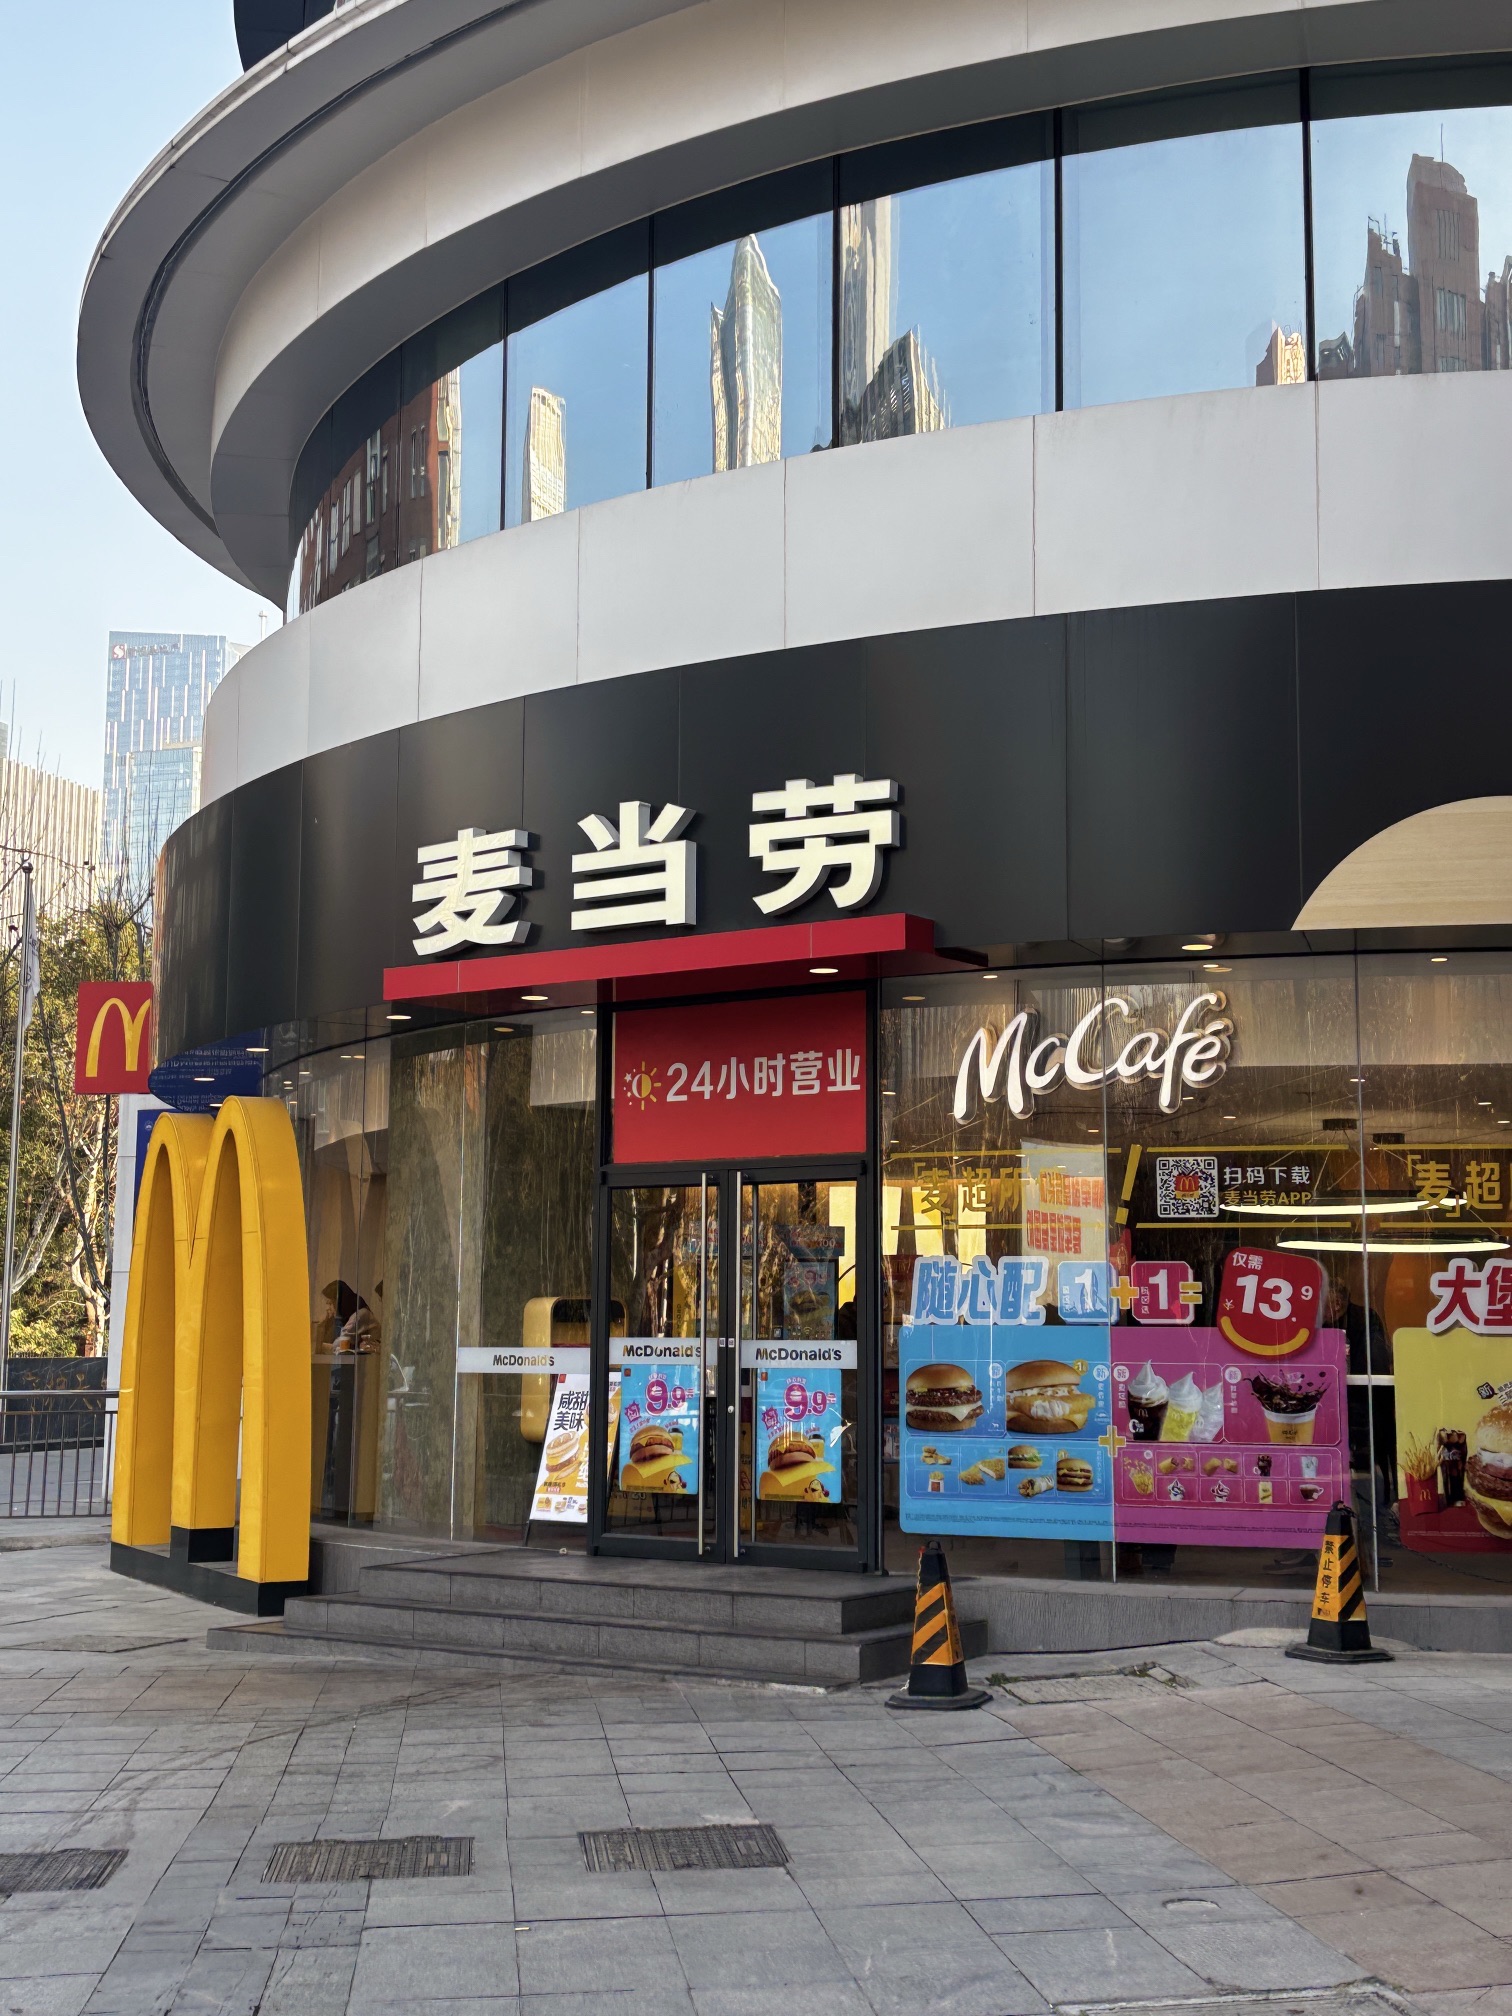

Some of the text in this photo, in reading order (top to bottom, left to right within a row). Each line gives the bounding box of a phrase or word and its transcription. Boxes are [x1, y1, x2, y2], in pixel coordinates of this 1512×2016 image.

[412, 773, 902, 956] 麦当劳
[953, 990, 1219, 1120] McCafé
[666, 1048, 862, 1102] 24小时营业
[1223, 1166, 1311, 1185] 扫码下载
[1407, 1155, 1512, 1217] 「麦超」
[1224, 1190, 1312, 1207] 麦当劳APP
[1232, 1251, 1264, 1271] 仅需
[915, 1260, 1043, 1320] 随心配
[493, 1354, 555, 1367] McDonald's
[623, 1344, 701, 1358] McDonald's
[755, 1347, 842, 1361] McDonald's
[558, 1391, 590, 1411] 咸甜
[553, 1411, 584, 1431] 美味
[1320, 1540, 1335, 1605] 禁止停车
